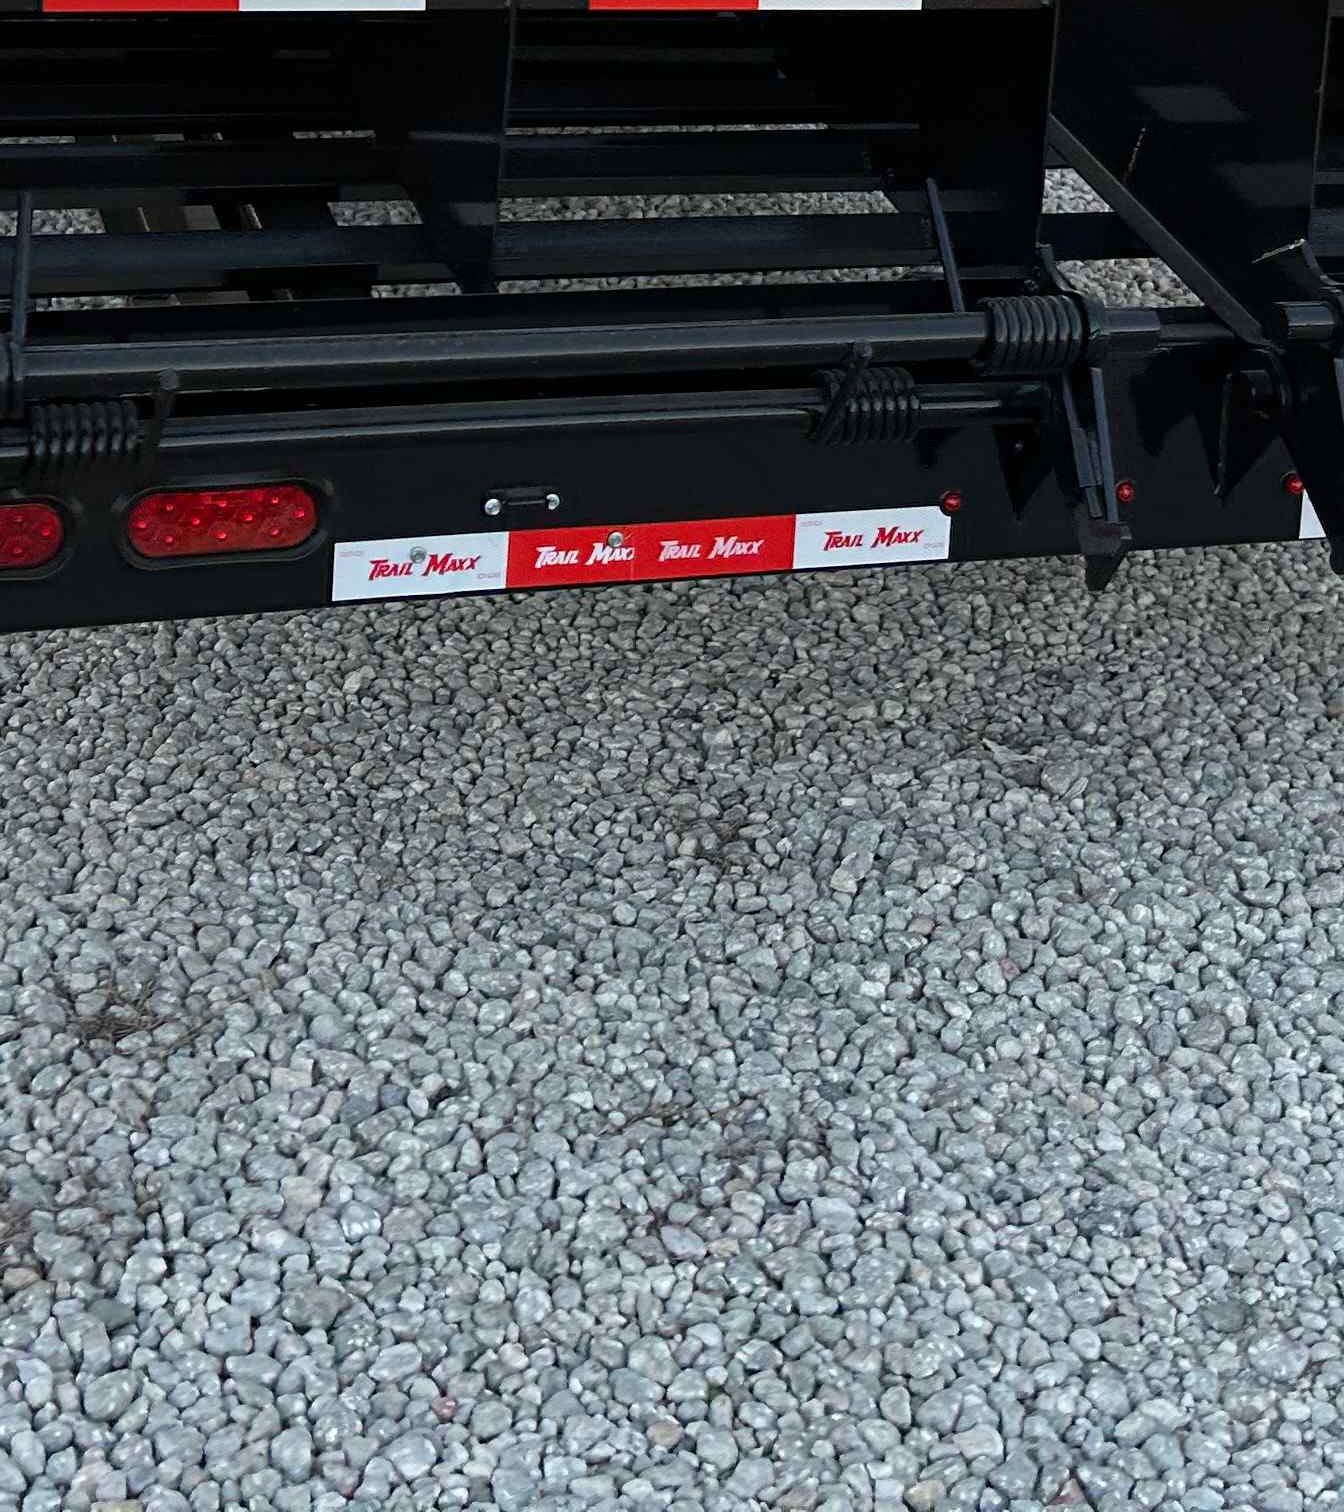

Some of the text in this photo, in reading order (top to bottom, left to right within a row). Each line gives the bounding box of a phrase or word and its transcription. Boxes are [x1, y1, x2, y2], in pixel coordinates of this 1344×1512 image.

[658, 535, 765, 562] TRAIL MAXX
[823, 530, 863, 551] TRAIL
[870, 525, 924, 548] MAXX
[368, 552, 480, 580] TRAIL MAXX
[534, 546, 579, 569] TRAIL
